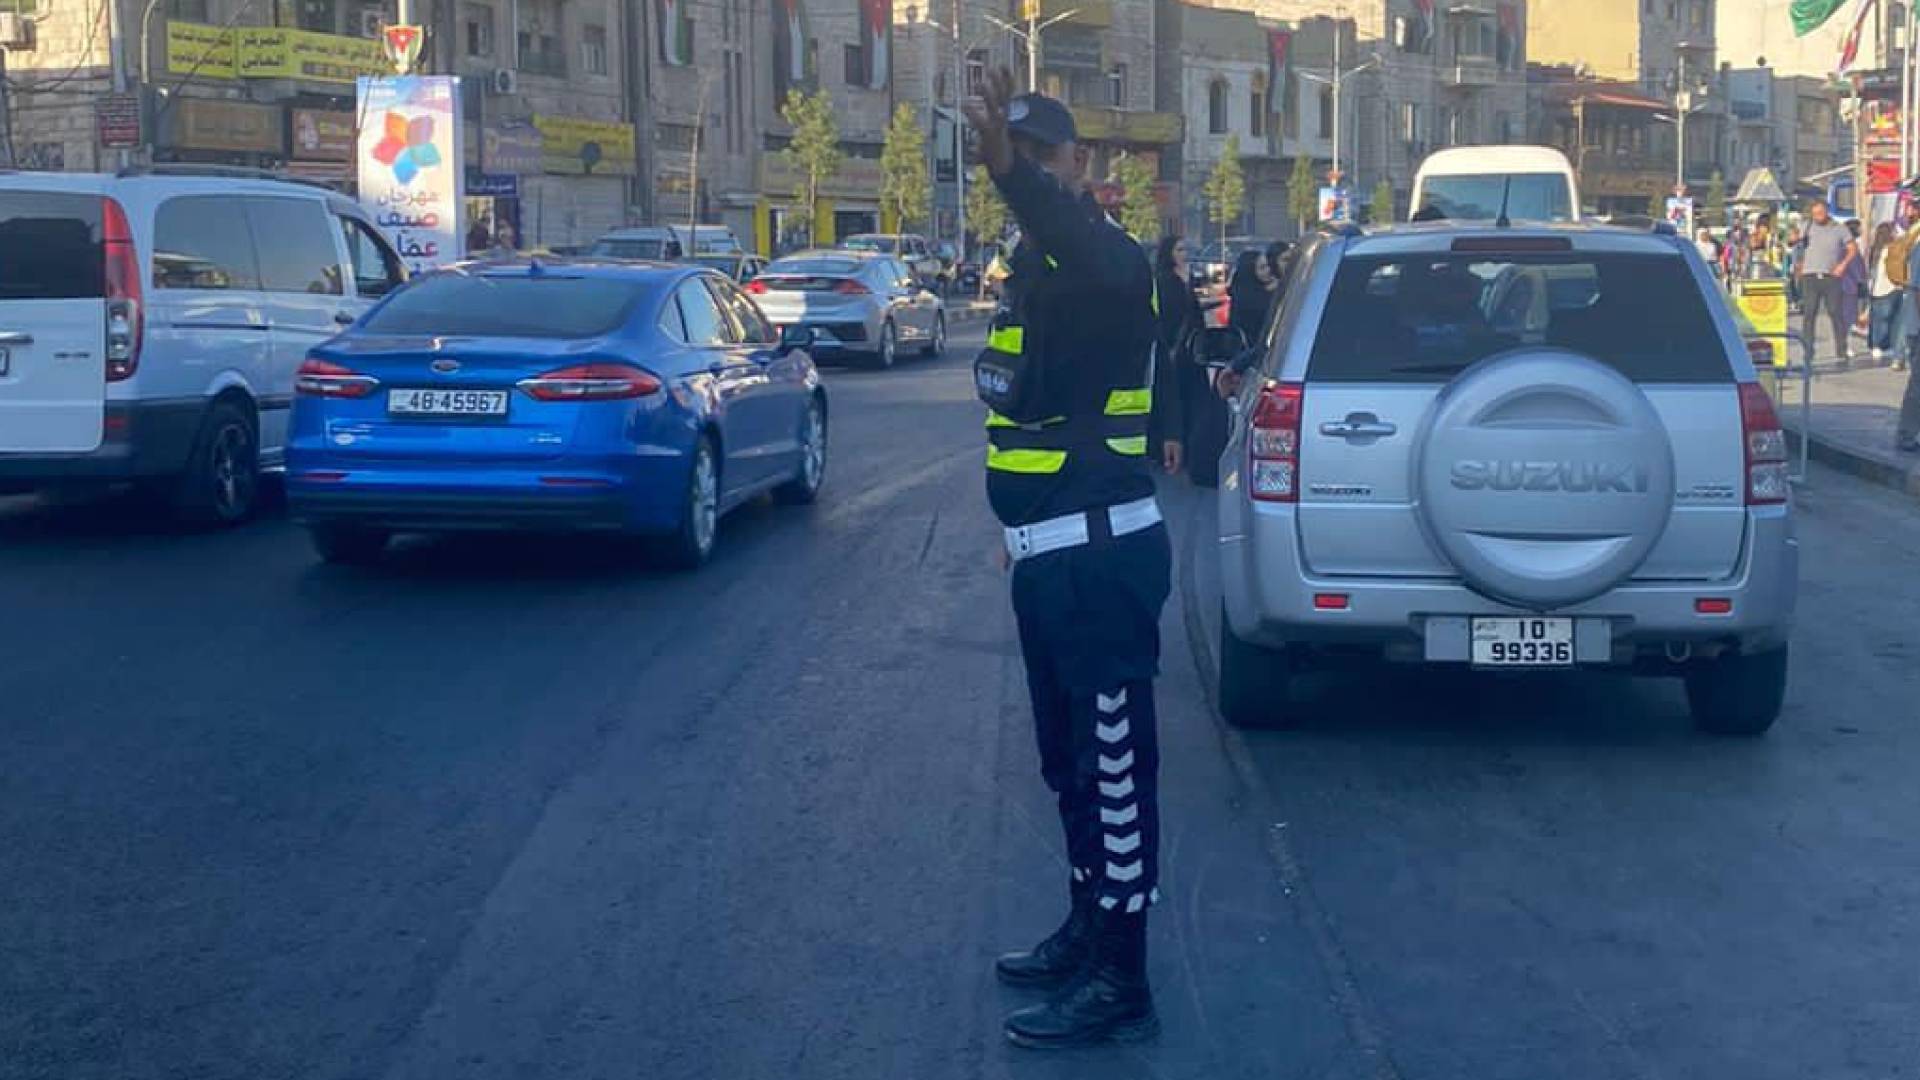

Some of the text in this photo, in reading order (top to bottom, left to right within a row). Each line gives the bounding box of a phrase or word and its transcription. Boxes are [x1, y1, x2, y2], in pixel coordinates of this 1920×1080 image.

[377, 206, 440, 231] صيف
[1450, 459, 1649, 493] SUZUKI
[1519, 619, 1546, 640] 10
[1491, 641, 1569, 661] 99336
